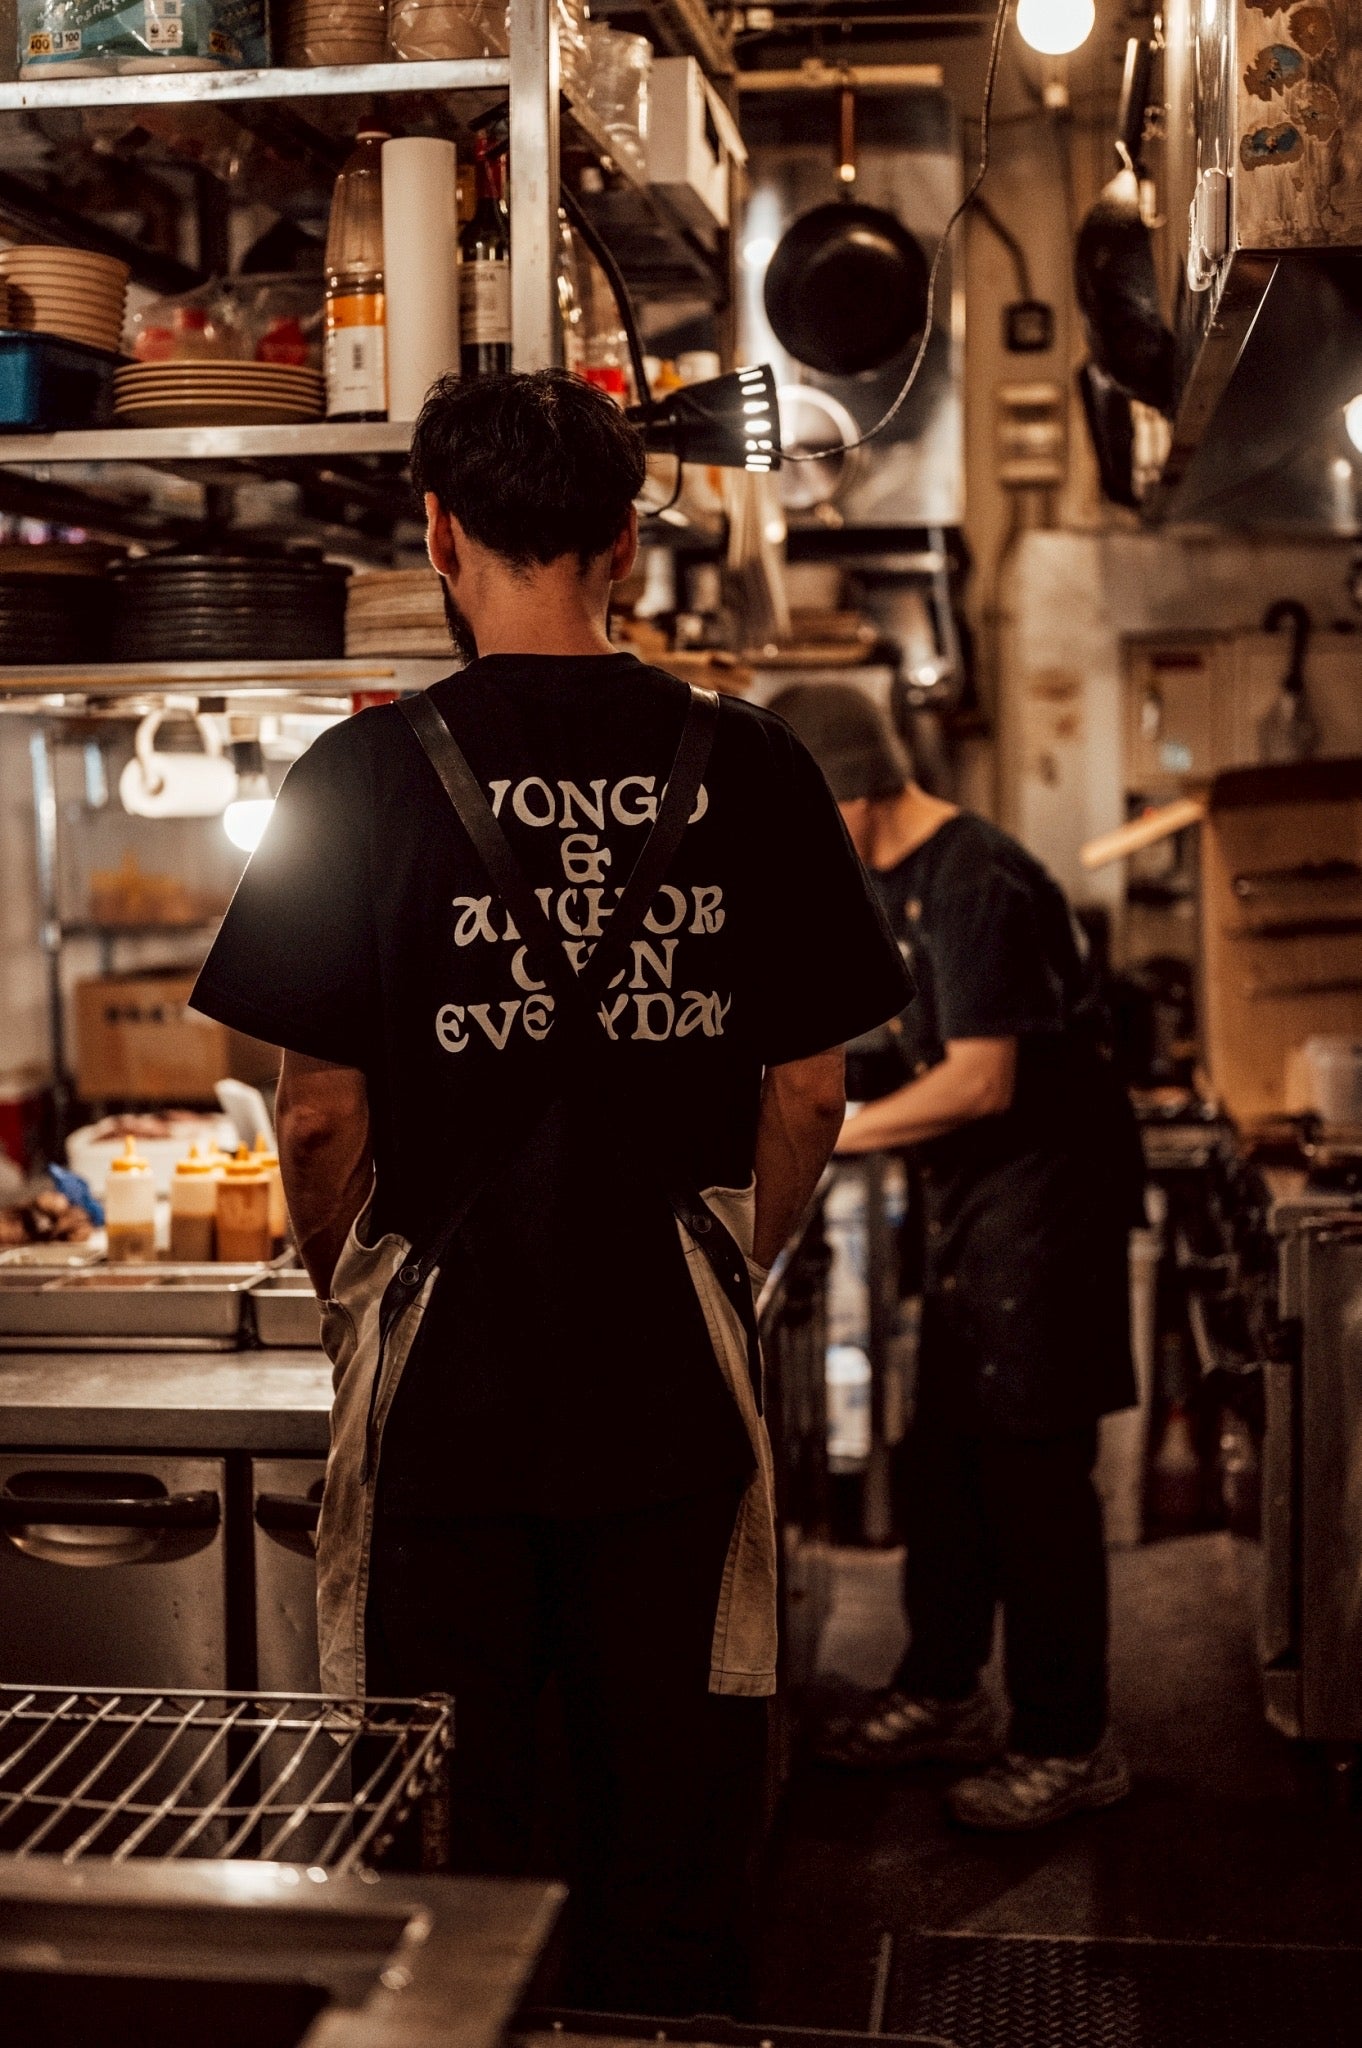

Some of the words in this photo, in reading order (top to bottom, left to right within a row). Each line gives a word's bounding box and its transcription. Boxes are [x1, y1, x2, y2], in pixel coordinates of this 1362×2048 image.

[65, 32, 80, 42] 100
[561, 834, 611, 883] &
[435, 991, 732, 1053] EVEYDAY
